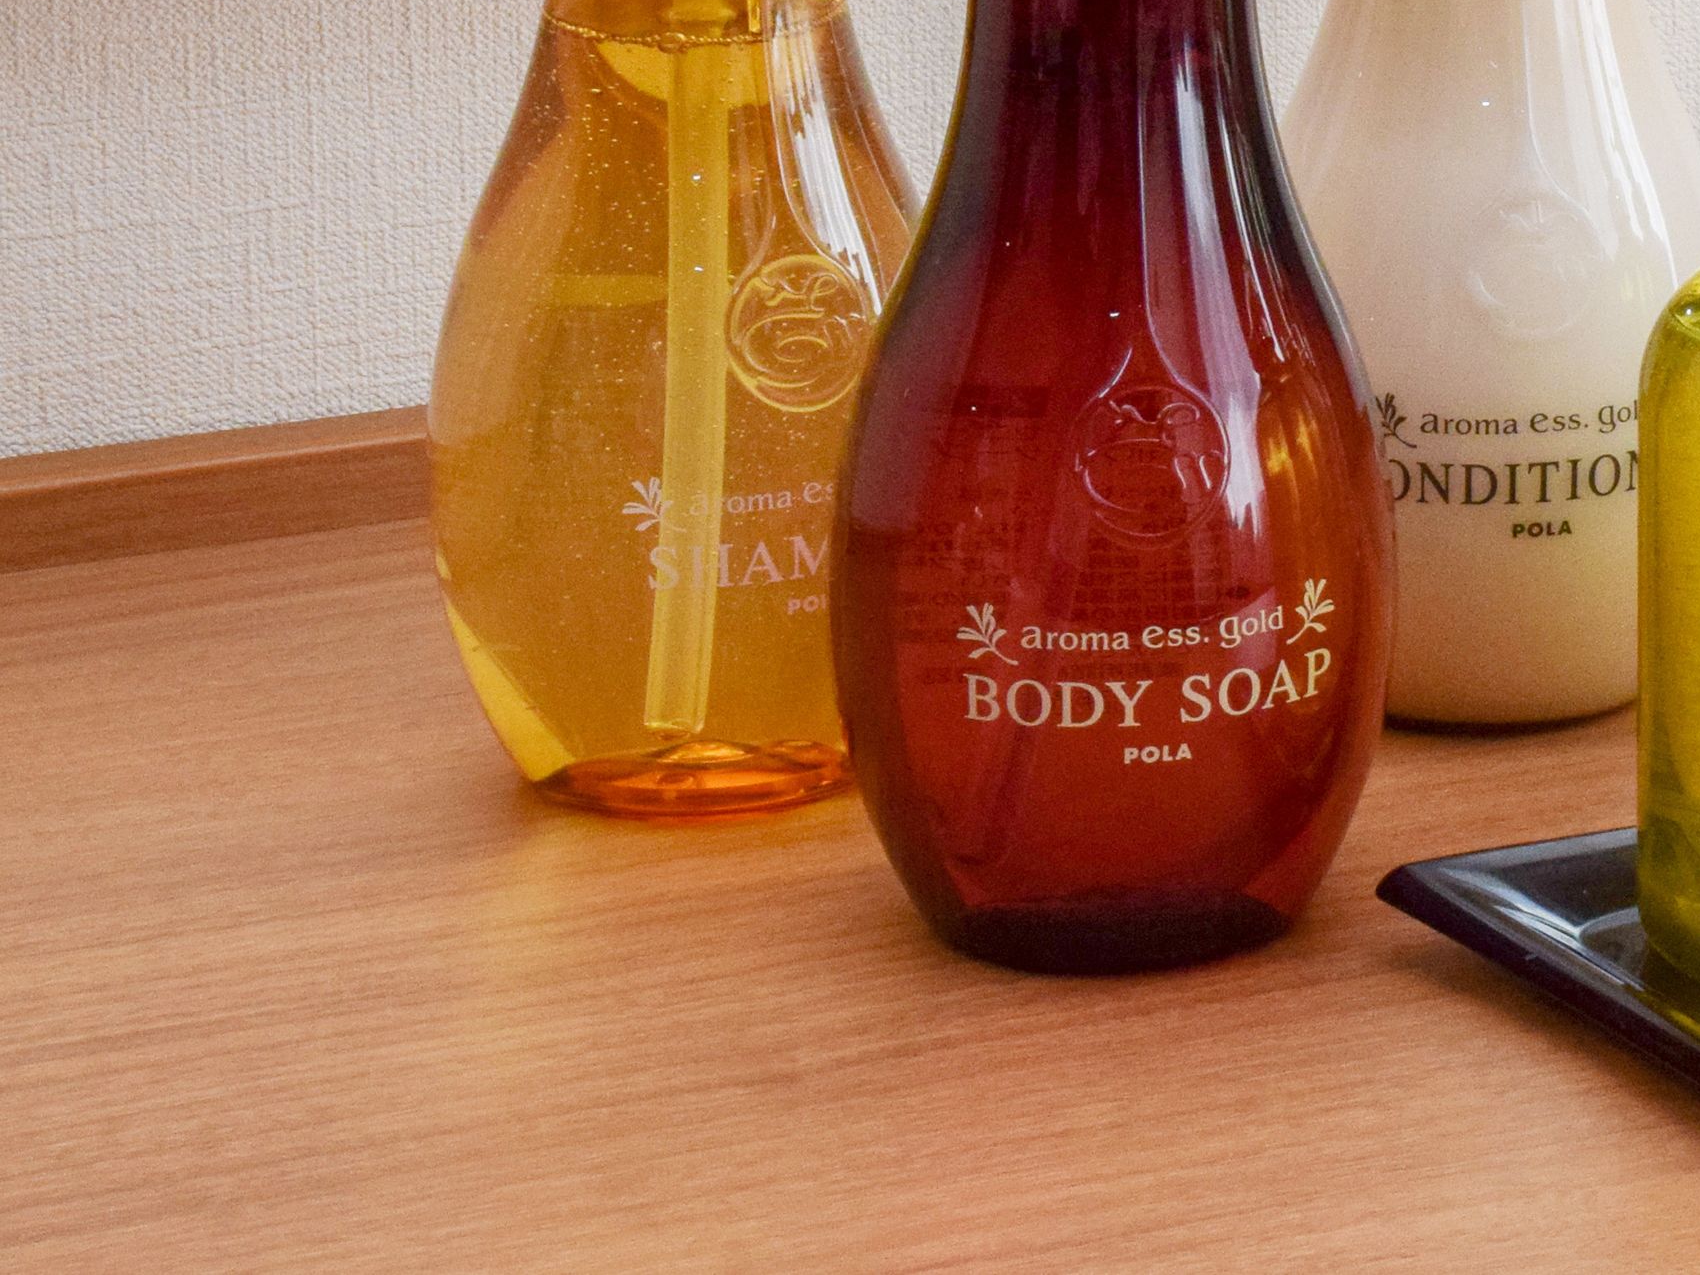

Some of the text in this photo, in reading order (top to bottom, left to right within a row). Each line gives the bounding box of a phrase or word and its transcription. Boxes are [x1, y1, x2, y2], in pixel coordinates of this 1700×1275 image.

[1421, 401, 1638, 435] aroma ess. gol
[1512, 521, 1572, 538] POLA
[648, 535, 832, 590] SHAM
[1021, 606, 1284, 651] aroma ess. gold
[963, 648, 1331, 727] BODY SOAP
[1124, 743, 1192, 763] POLA
